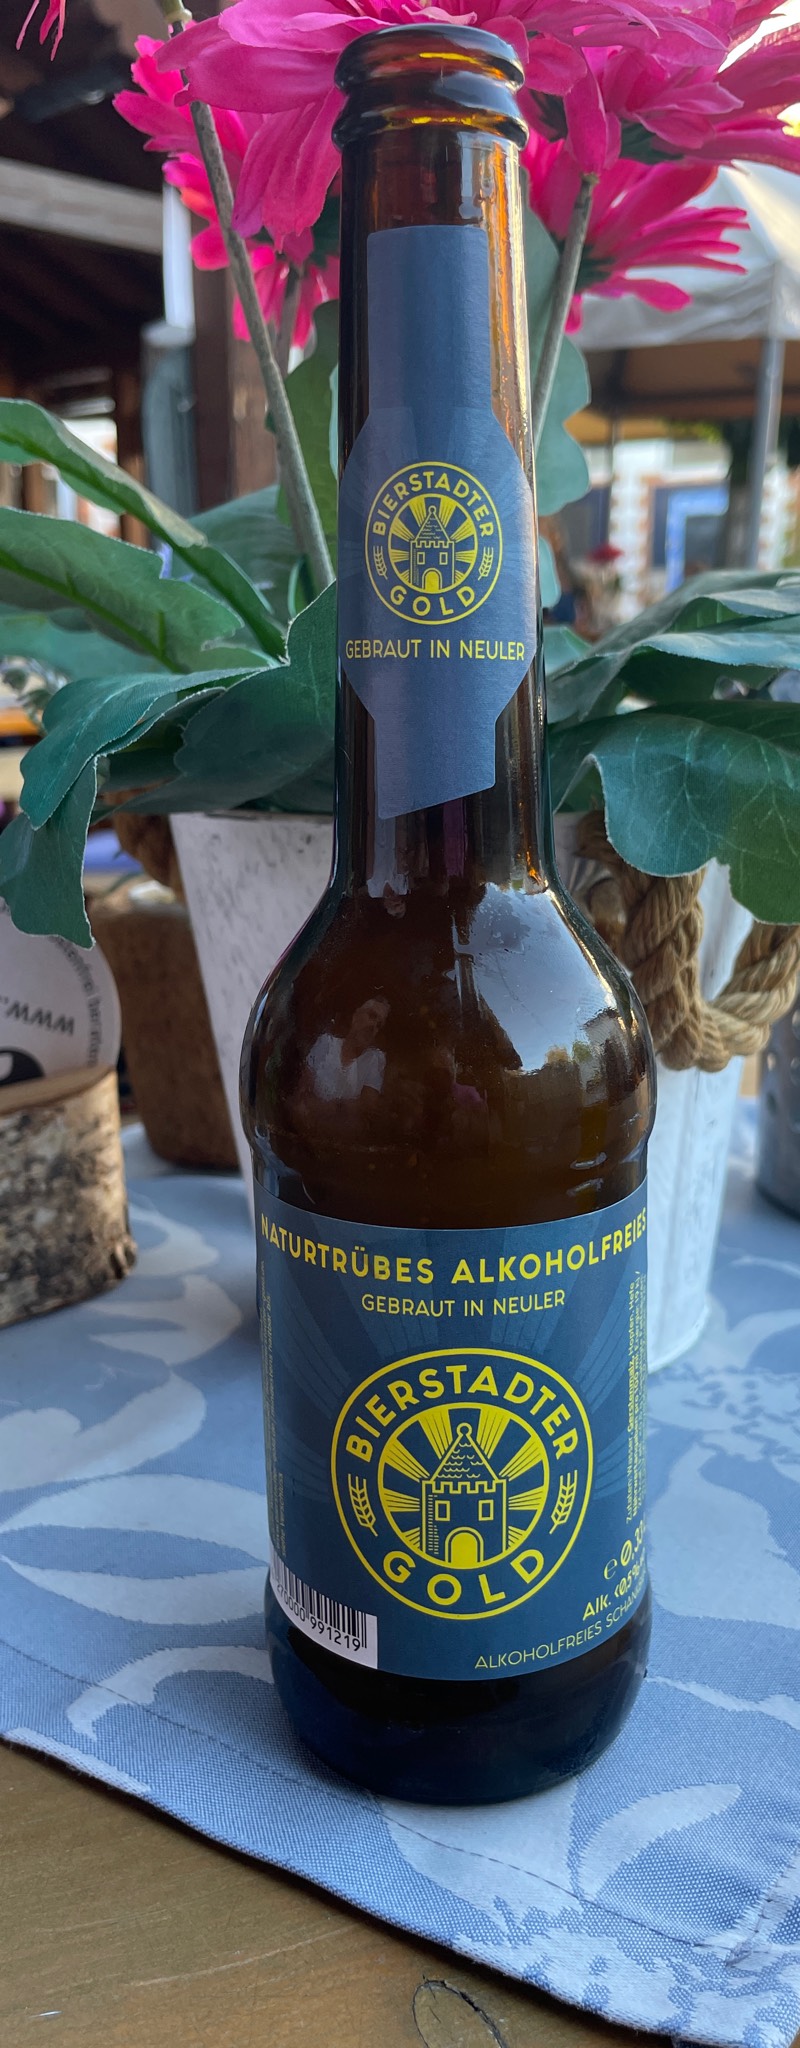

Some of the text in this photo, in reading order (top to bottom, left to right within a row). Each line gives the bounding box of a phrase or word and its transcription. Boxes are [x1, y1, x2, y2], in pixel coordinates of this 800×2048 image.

[372, 471, 494, 537] BIERSTADTER
[389, 585, 475, 616] GOLD
[345, 639, 525, 661] GEBRAUT IN NEULER
[261, 1206, 646, 1285] NATURTRÜBES ALKOHOLFREIES
[361, 1289, 566, 1318] GEBRAUT IN NEULER
[346, 1364, 579, 1463] BIERSTADTER
[383, 1548, 545, 1606] GOLD
[582, 1594, 611, 1621] Alk.
[310, 1616, 361, 1652] 991219
[475, 1620, 602, 1669] ALKOHOLFREIES
